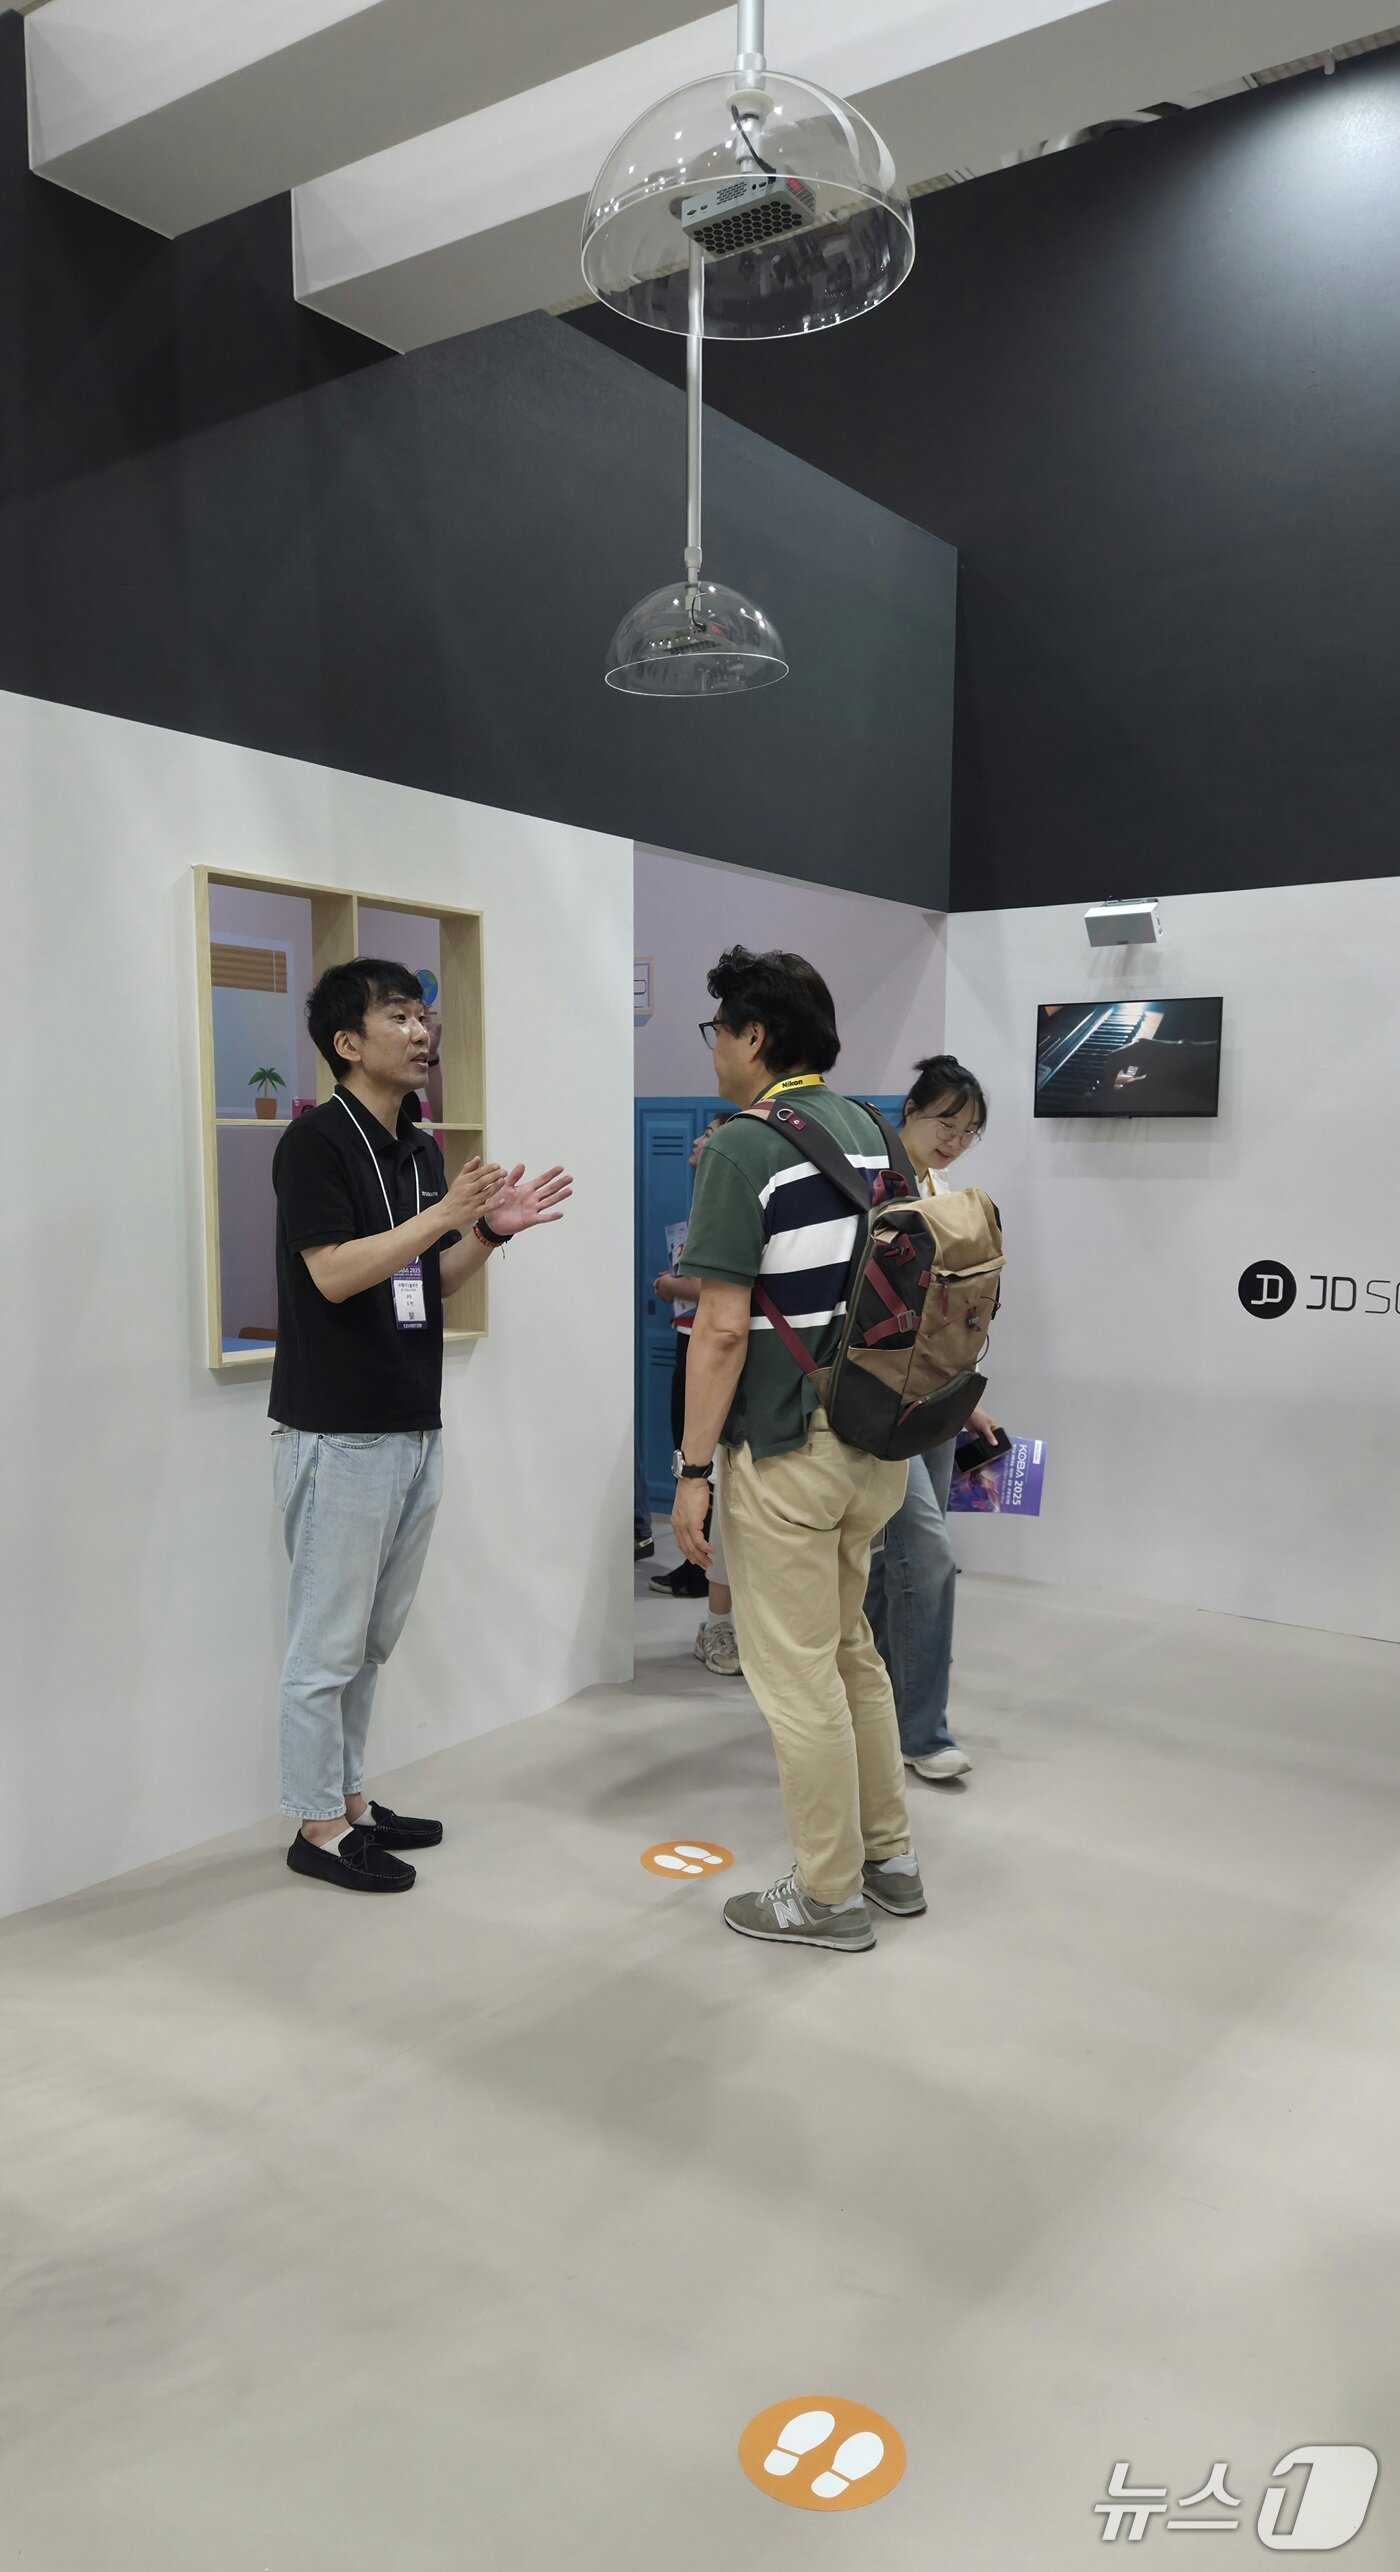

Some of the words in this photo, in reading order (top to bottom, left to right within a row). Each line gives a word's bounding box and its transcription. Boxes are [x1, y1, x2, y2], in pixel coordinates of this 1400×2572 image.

[782, 1079, 803, 1089] Nikon
[1306, 1275, 1356, 1311] JD
[1364, 1280, 1400, 1314] S
[1015, 1444, 1028, 1478] KOBA
[1012, 1480, 1023, 1506] 2025
